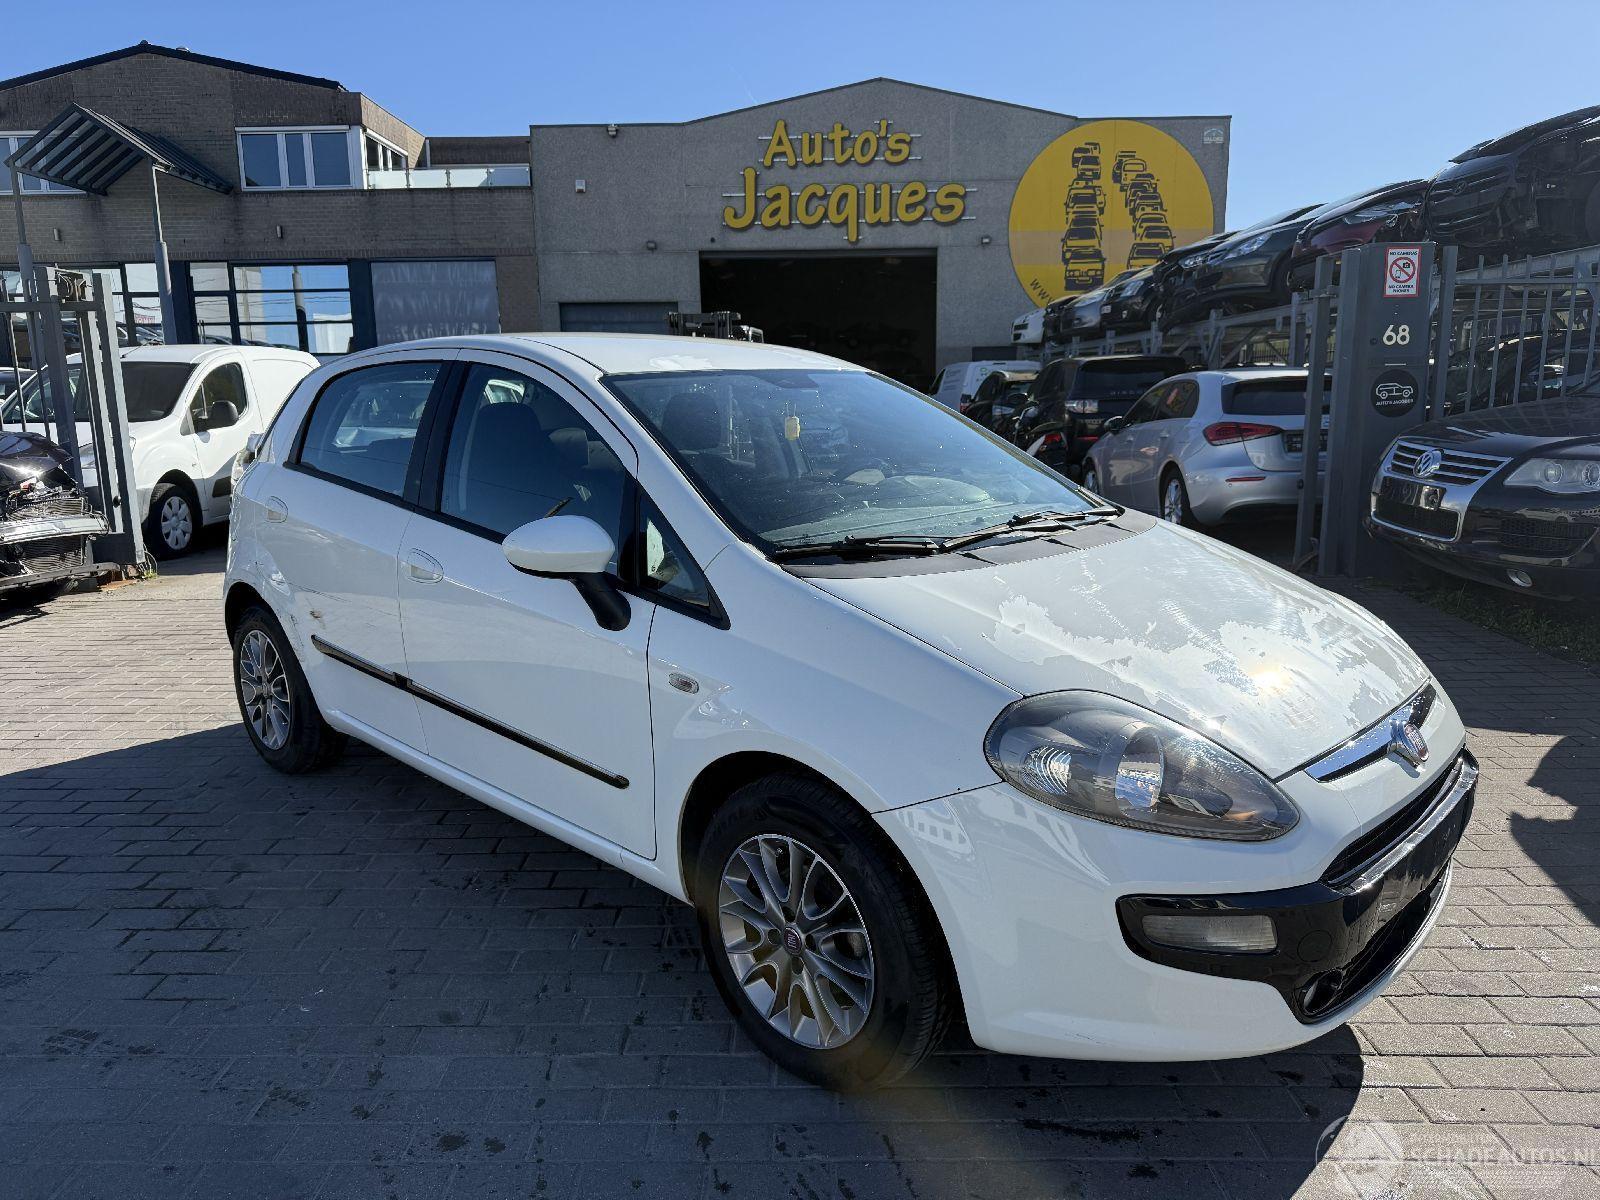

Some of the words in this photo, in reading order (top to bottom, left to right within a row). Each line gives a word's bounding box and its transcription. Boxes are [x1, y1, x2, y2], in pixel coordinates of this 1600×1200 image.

[763, 119, 911, 167] Auto's
[723, 167, 966, 243] Jacques
[1383, 324, 1410, 346] 68
